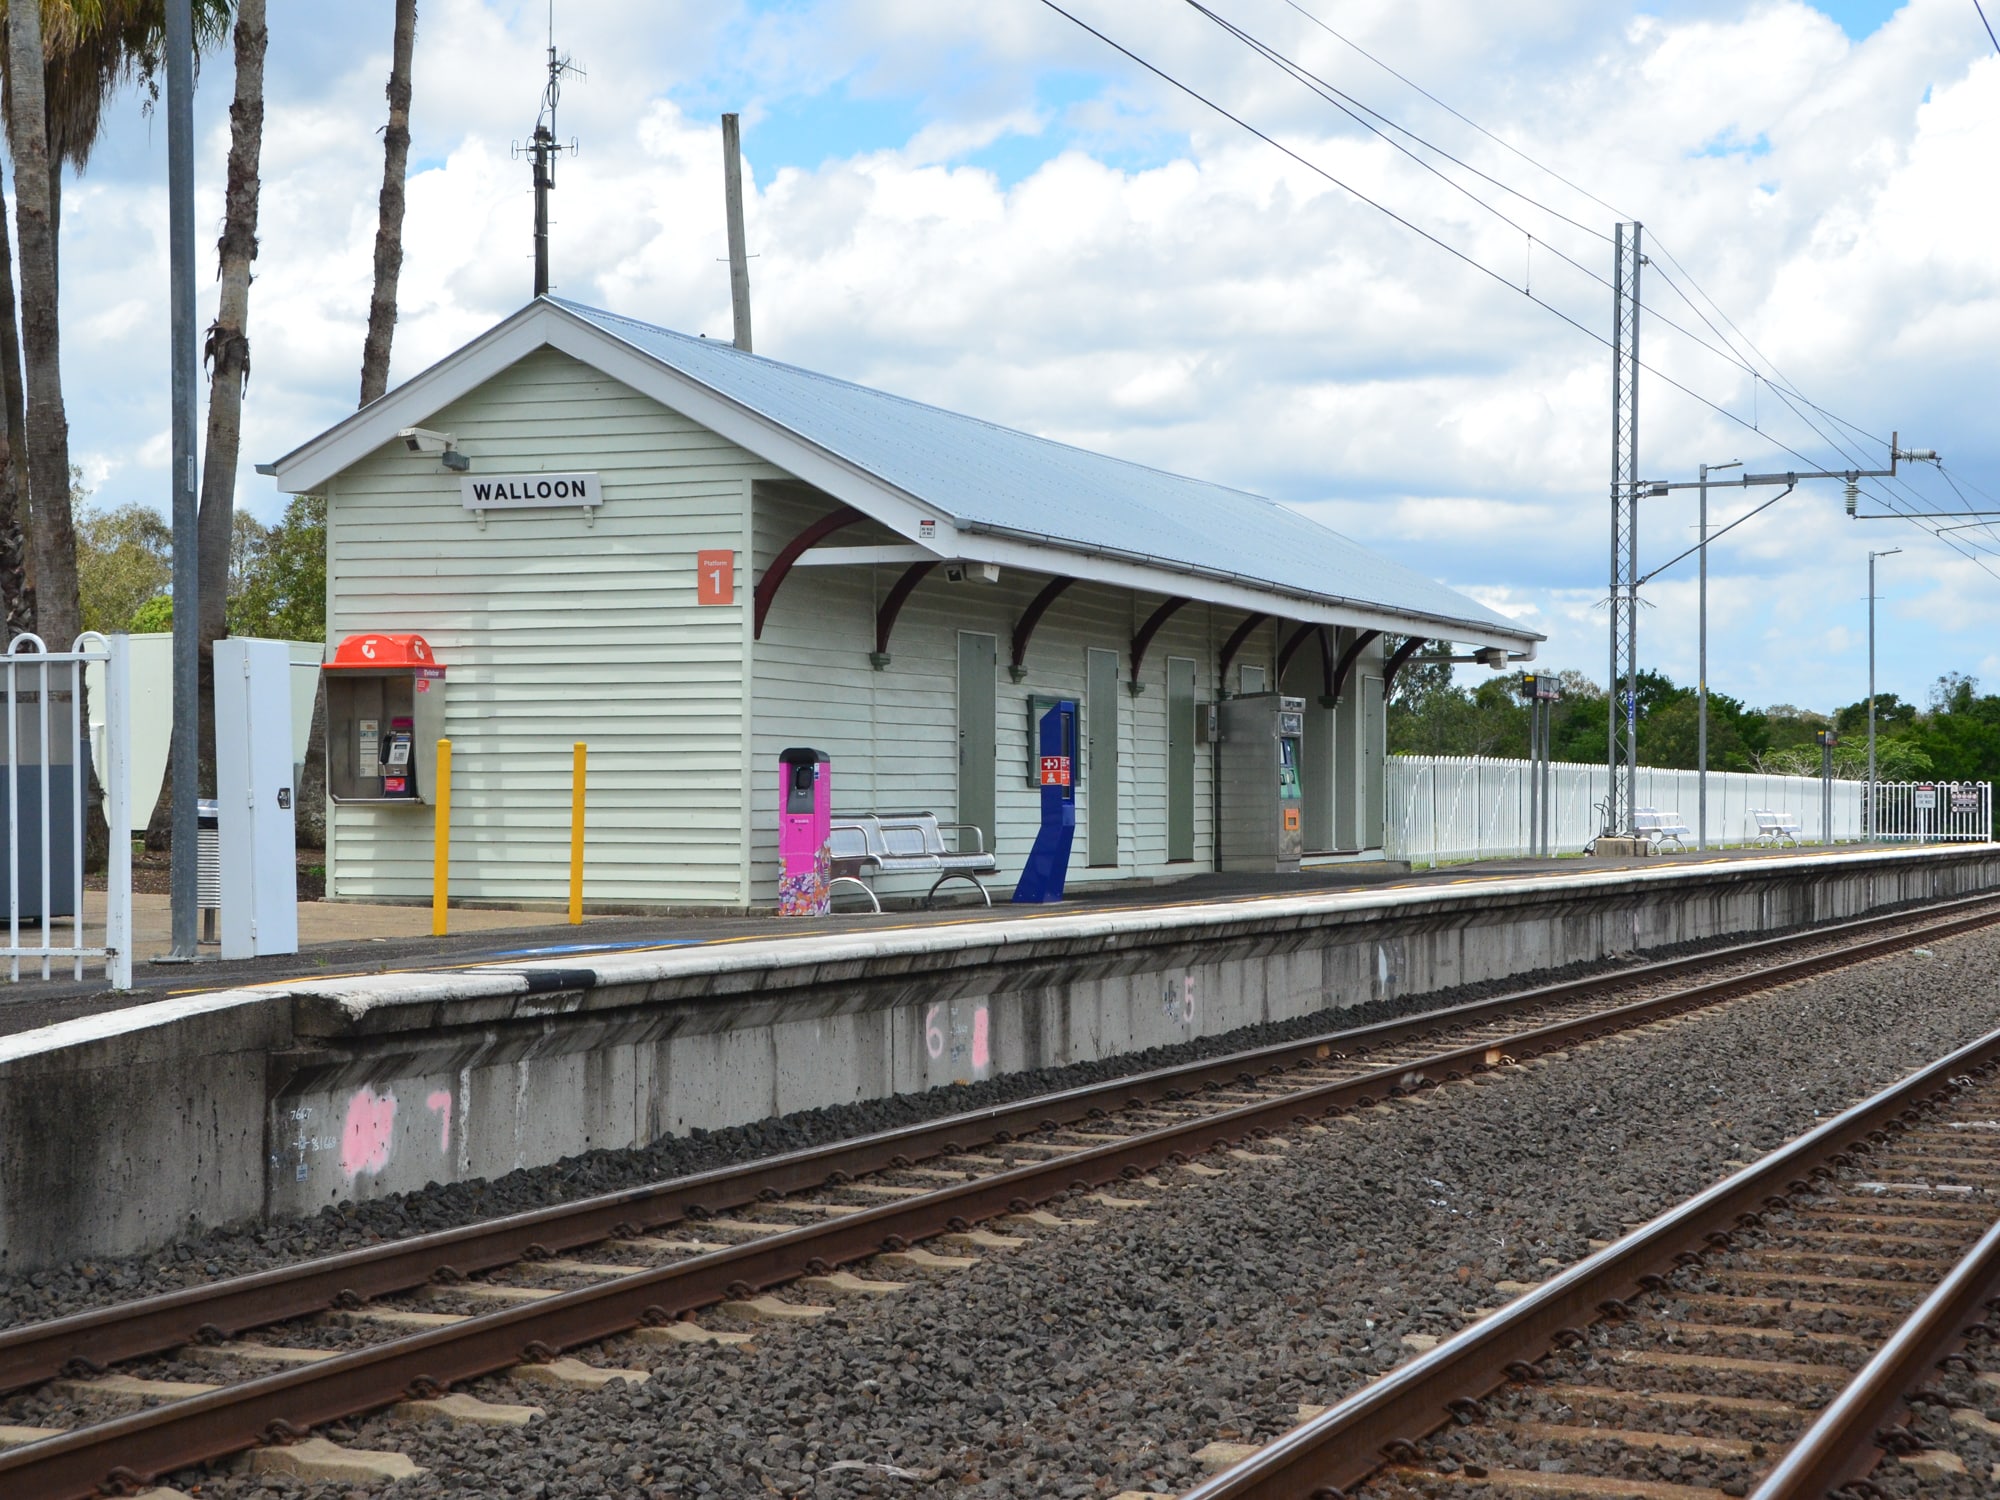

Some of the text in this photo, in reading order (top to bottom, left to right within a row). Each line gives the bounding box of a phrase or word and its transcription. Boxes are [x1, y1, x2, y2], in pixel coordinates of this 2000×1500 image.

[473, 480, 586, 500] WALLOON
[709, 569, 720, 595] 1
[926, 1004, 943, 1059] 6
